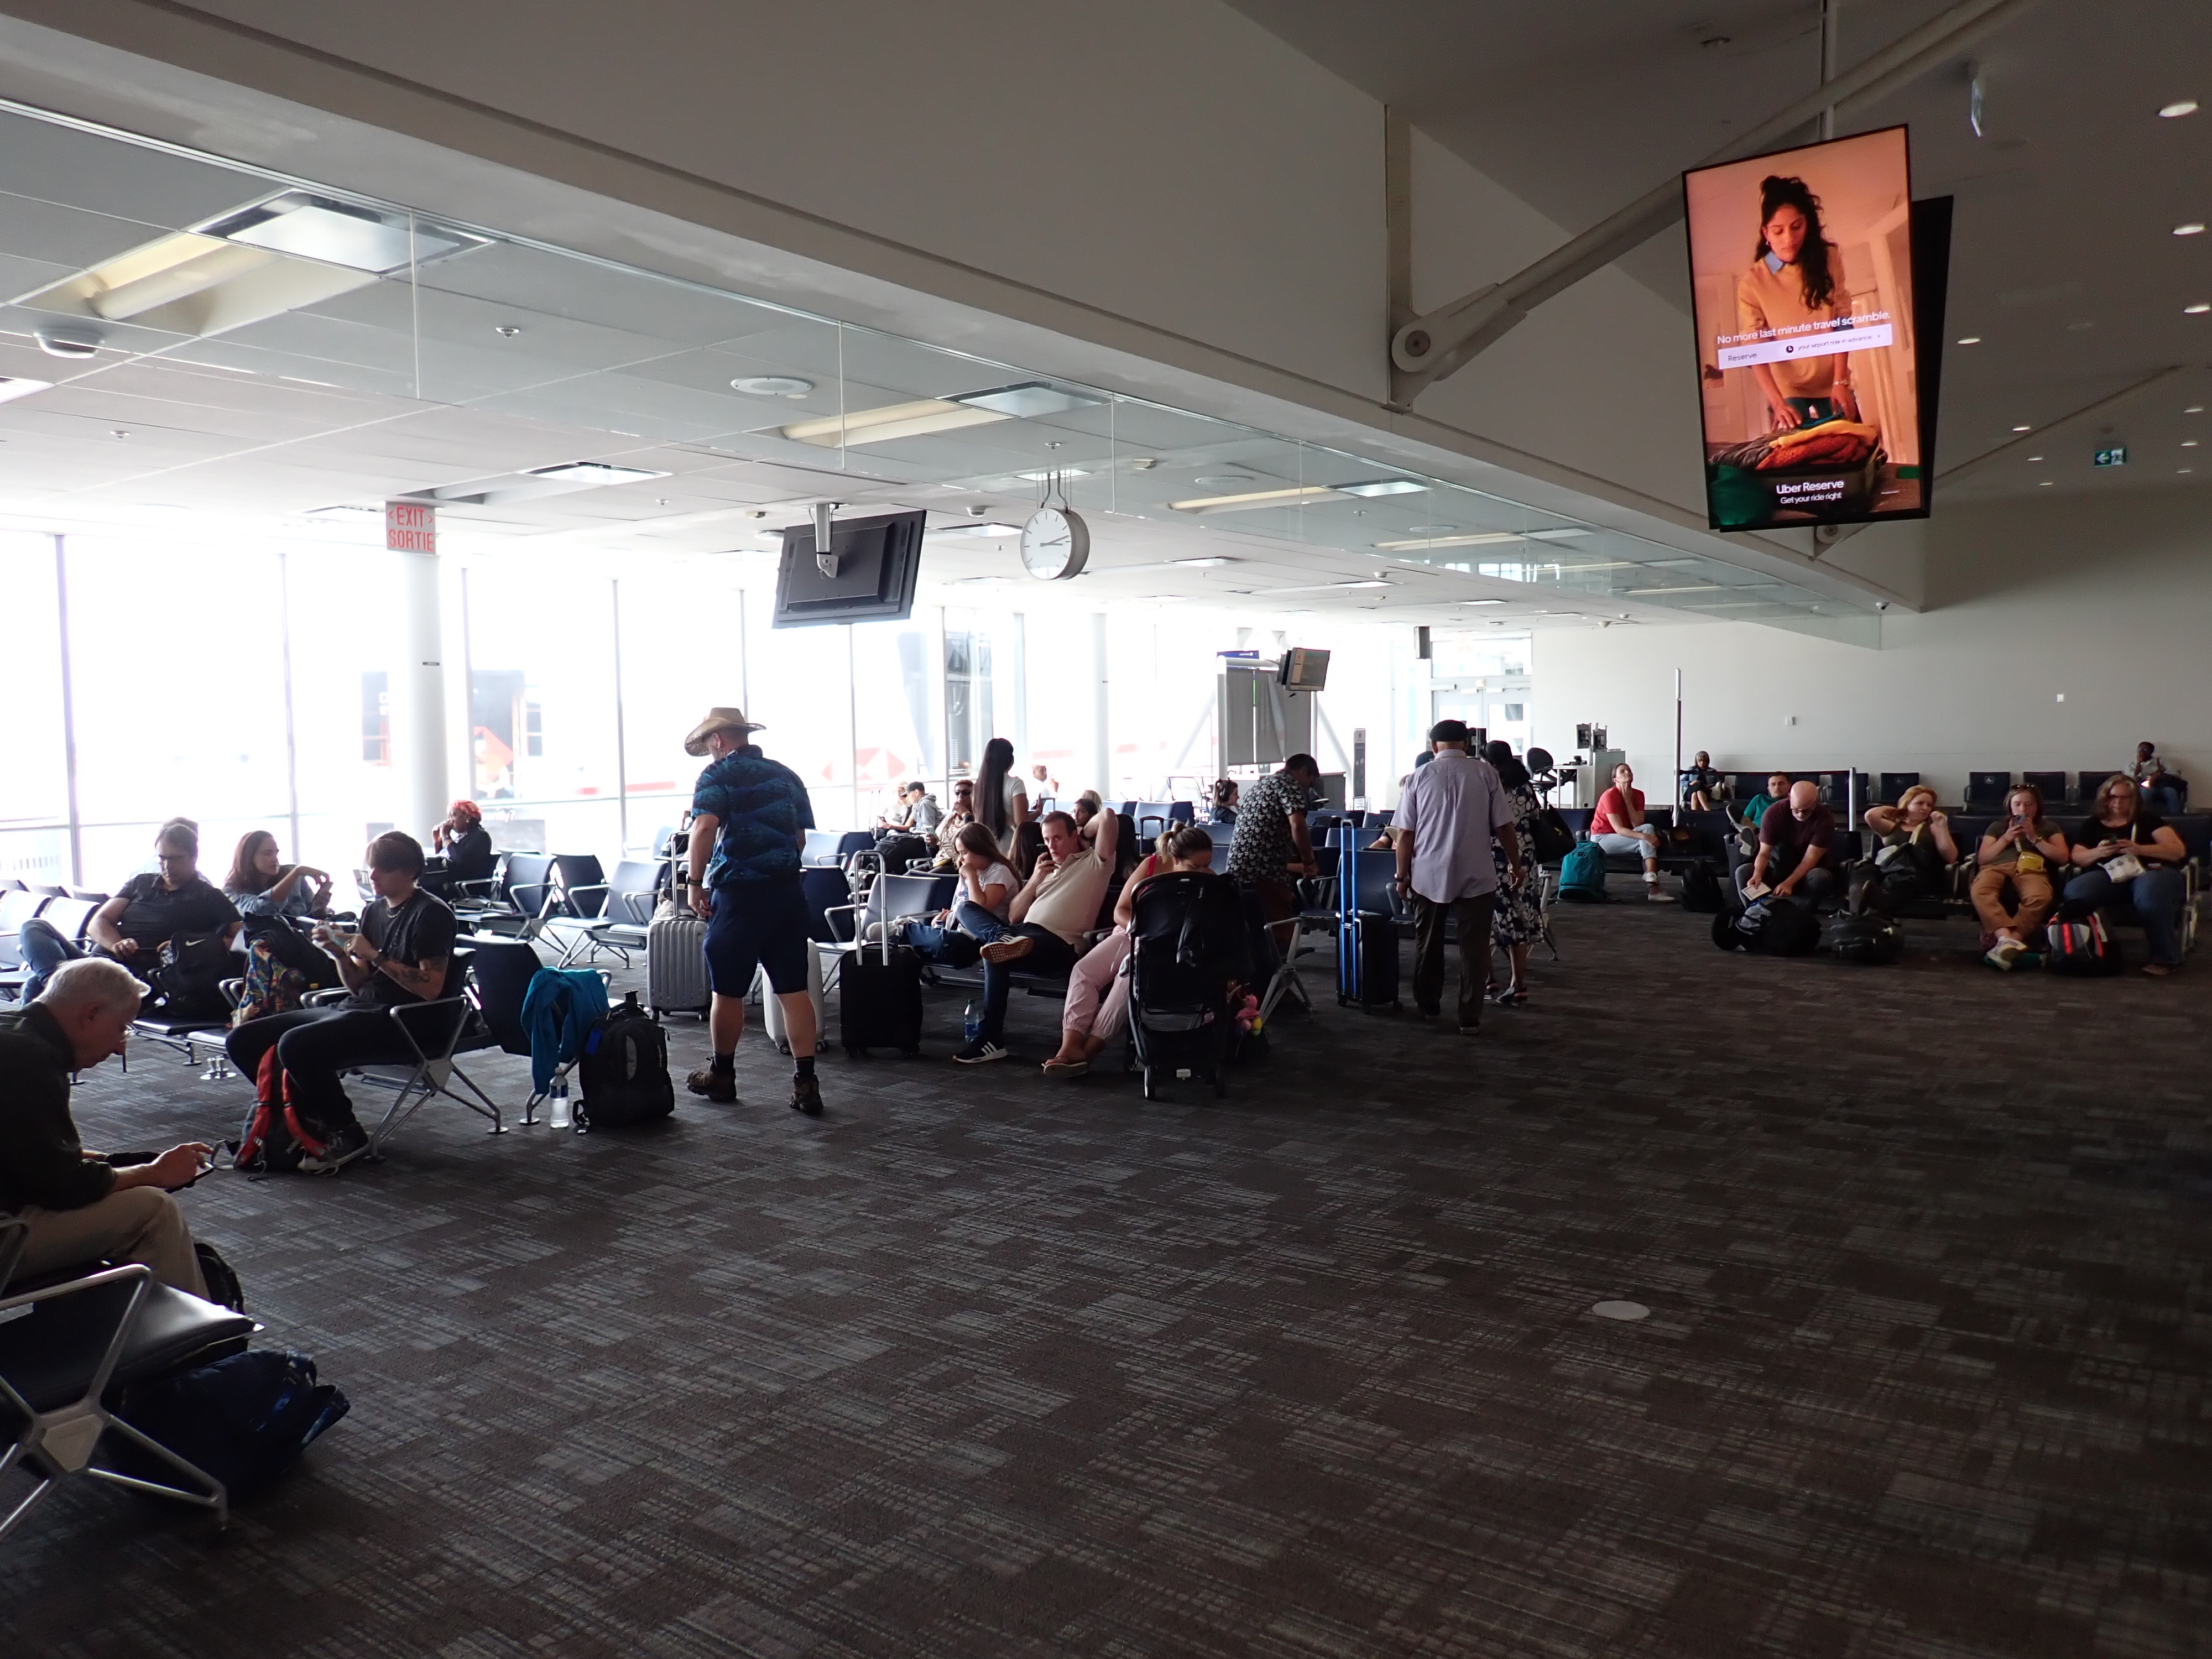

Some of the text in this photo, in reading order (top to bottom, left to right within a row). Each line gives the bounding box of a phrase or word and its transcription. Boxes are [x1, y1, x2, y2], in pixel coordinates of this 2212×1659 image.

[1717, 310, 1891, 345] No more last minute travel scramble.
[1728, 353, 1757, 361] Reserve
[1776, 481, 1844, 494] Uber Reserve
[1794, 495, 1810, 504] your
[1825, 492, 1842, 501] right
[397, 505, 425, 528] EXIT
[389, 529, 434, 552] SORTIE
